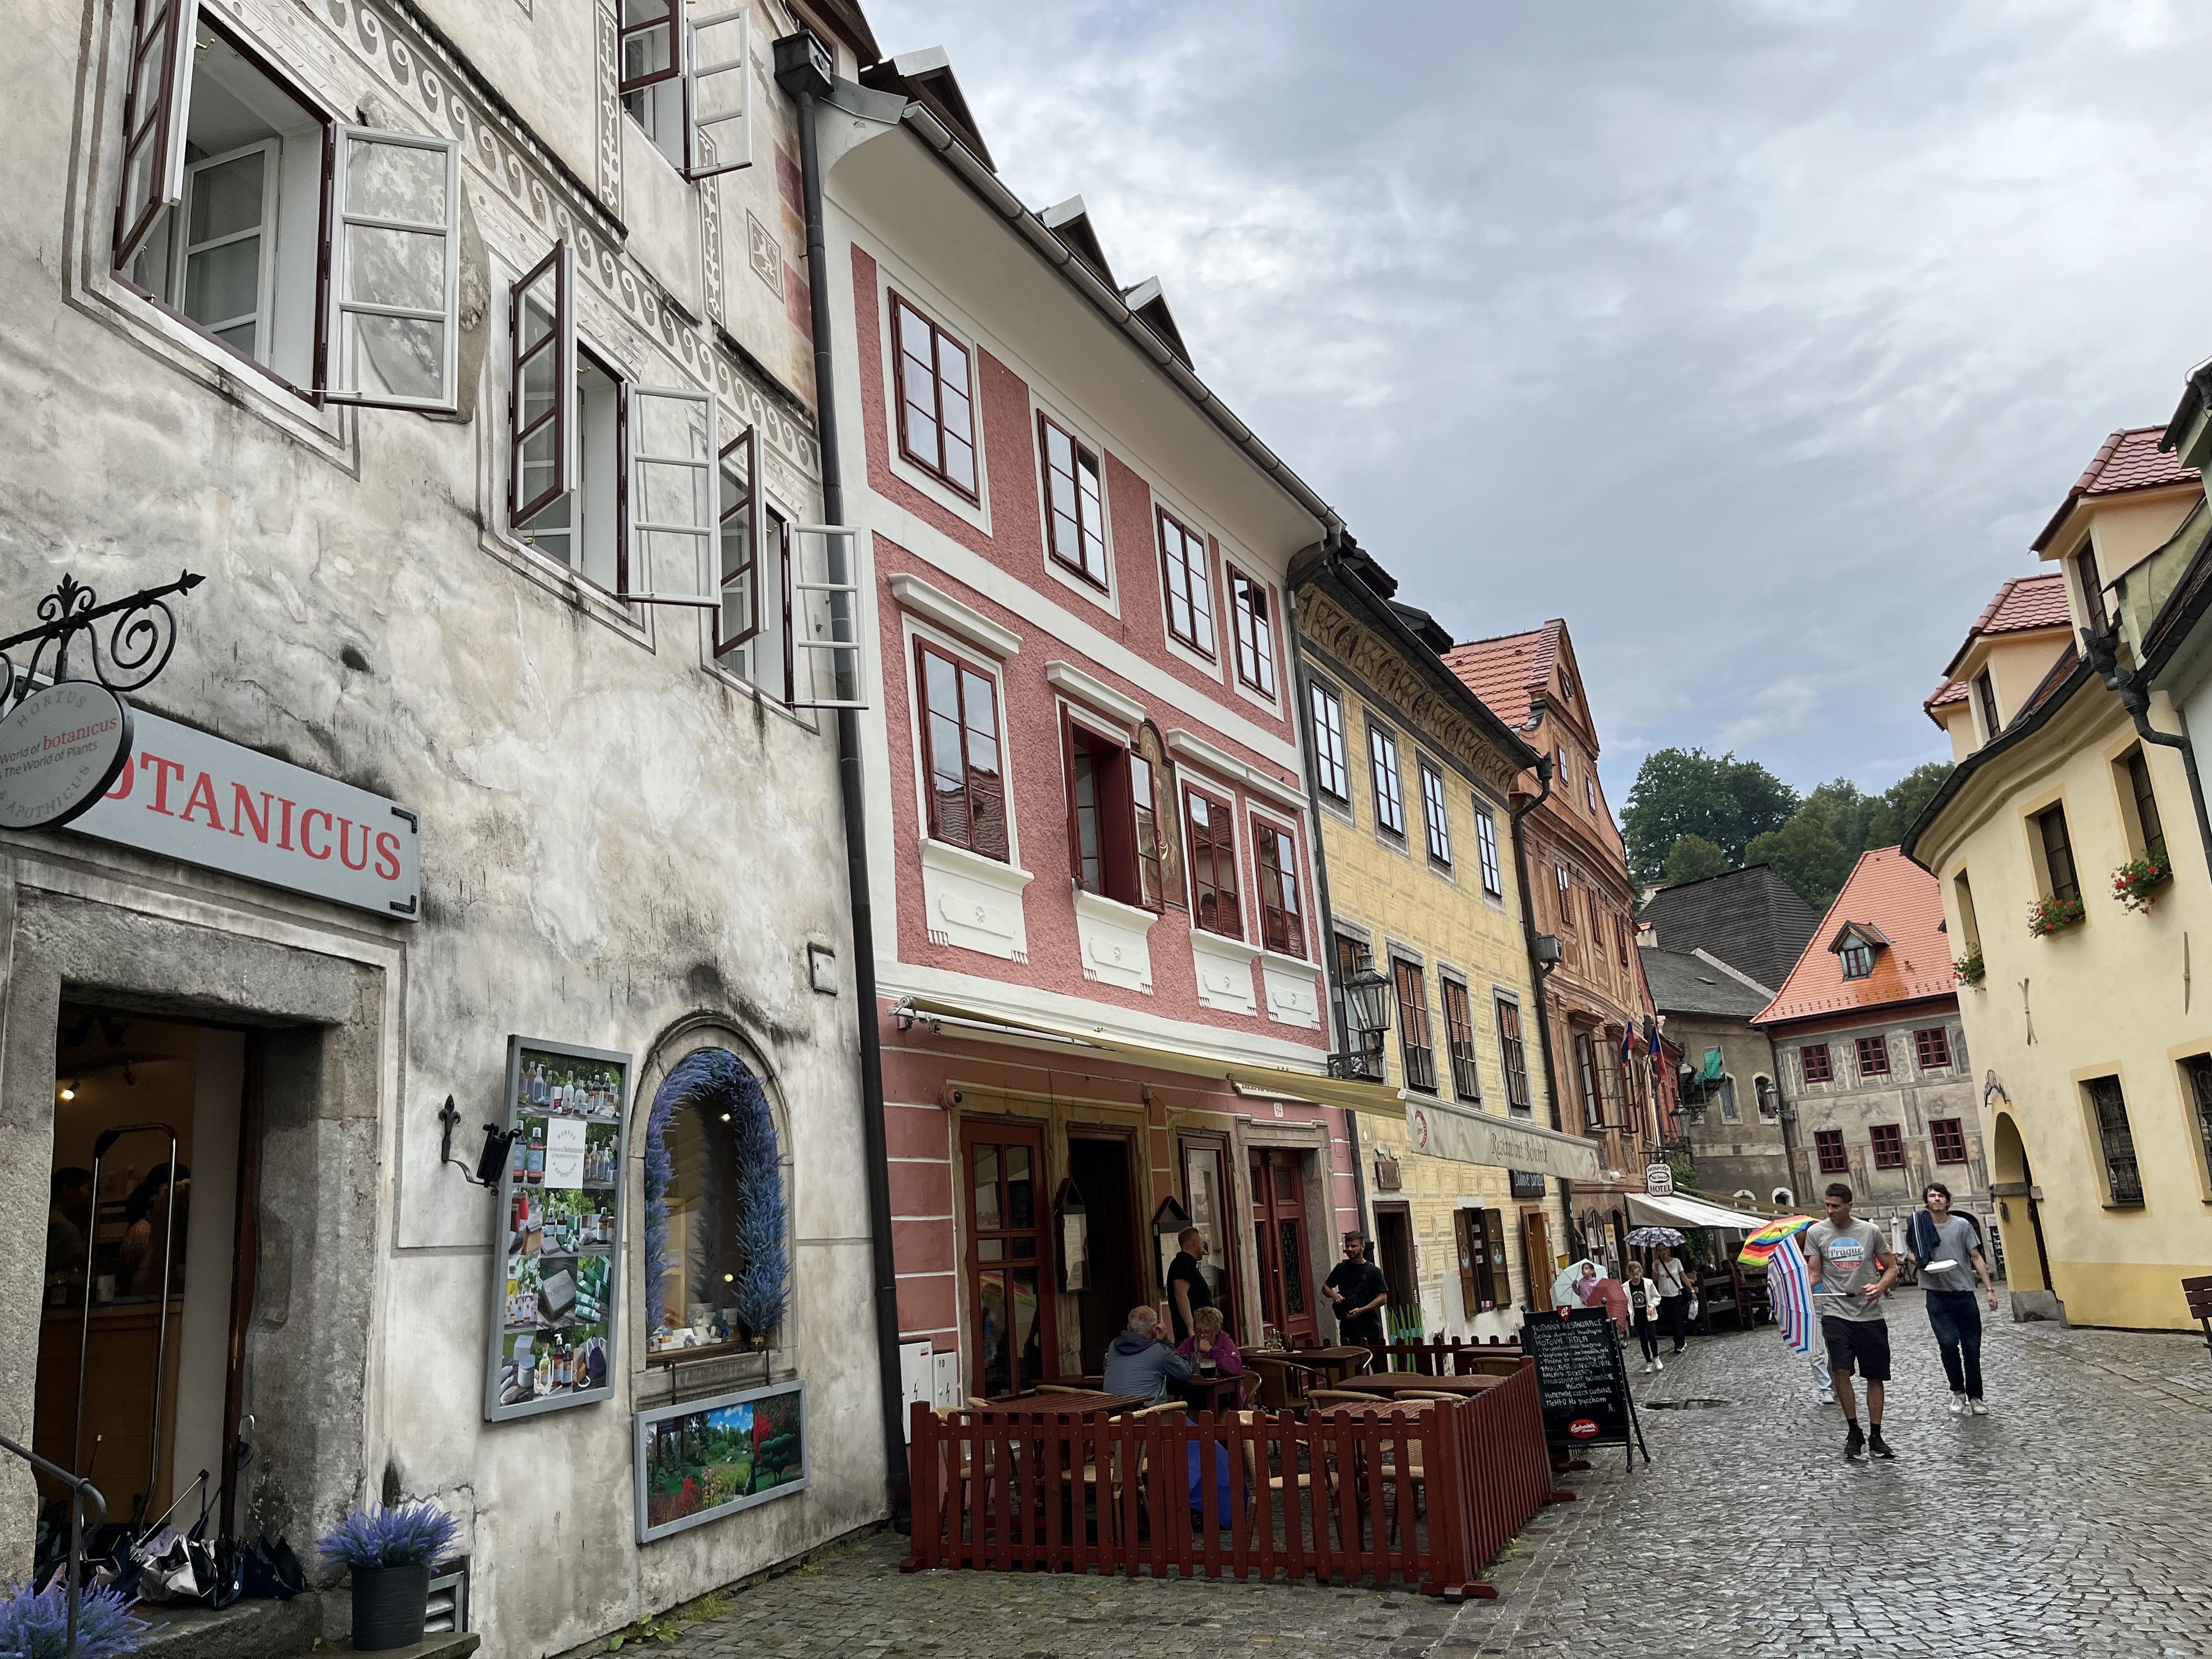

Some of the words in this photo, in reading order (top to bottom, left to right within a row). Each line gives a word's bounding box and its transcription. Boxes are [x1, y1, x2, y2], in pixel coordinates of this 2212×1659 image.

[18, 691, 86, 727] HORTUS
[0, 744, 28, 764] World
[31, 742, 41, 755] of
[43, 717, 117, 751] botanicus
[4, 765, 22, 778] The
[23, 753, 53, 772] World
[55, 748, 65, 762] of
[67, 740, 98, 759] Plants
[7, 765, 90, 819] APOTHICUS
[104, 752, 400, 880] OTANICUS
[1275, 1104, 1282, 1116] 64
[1830, 1247, 1862, 1258] Prague
